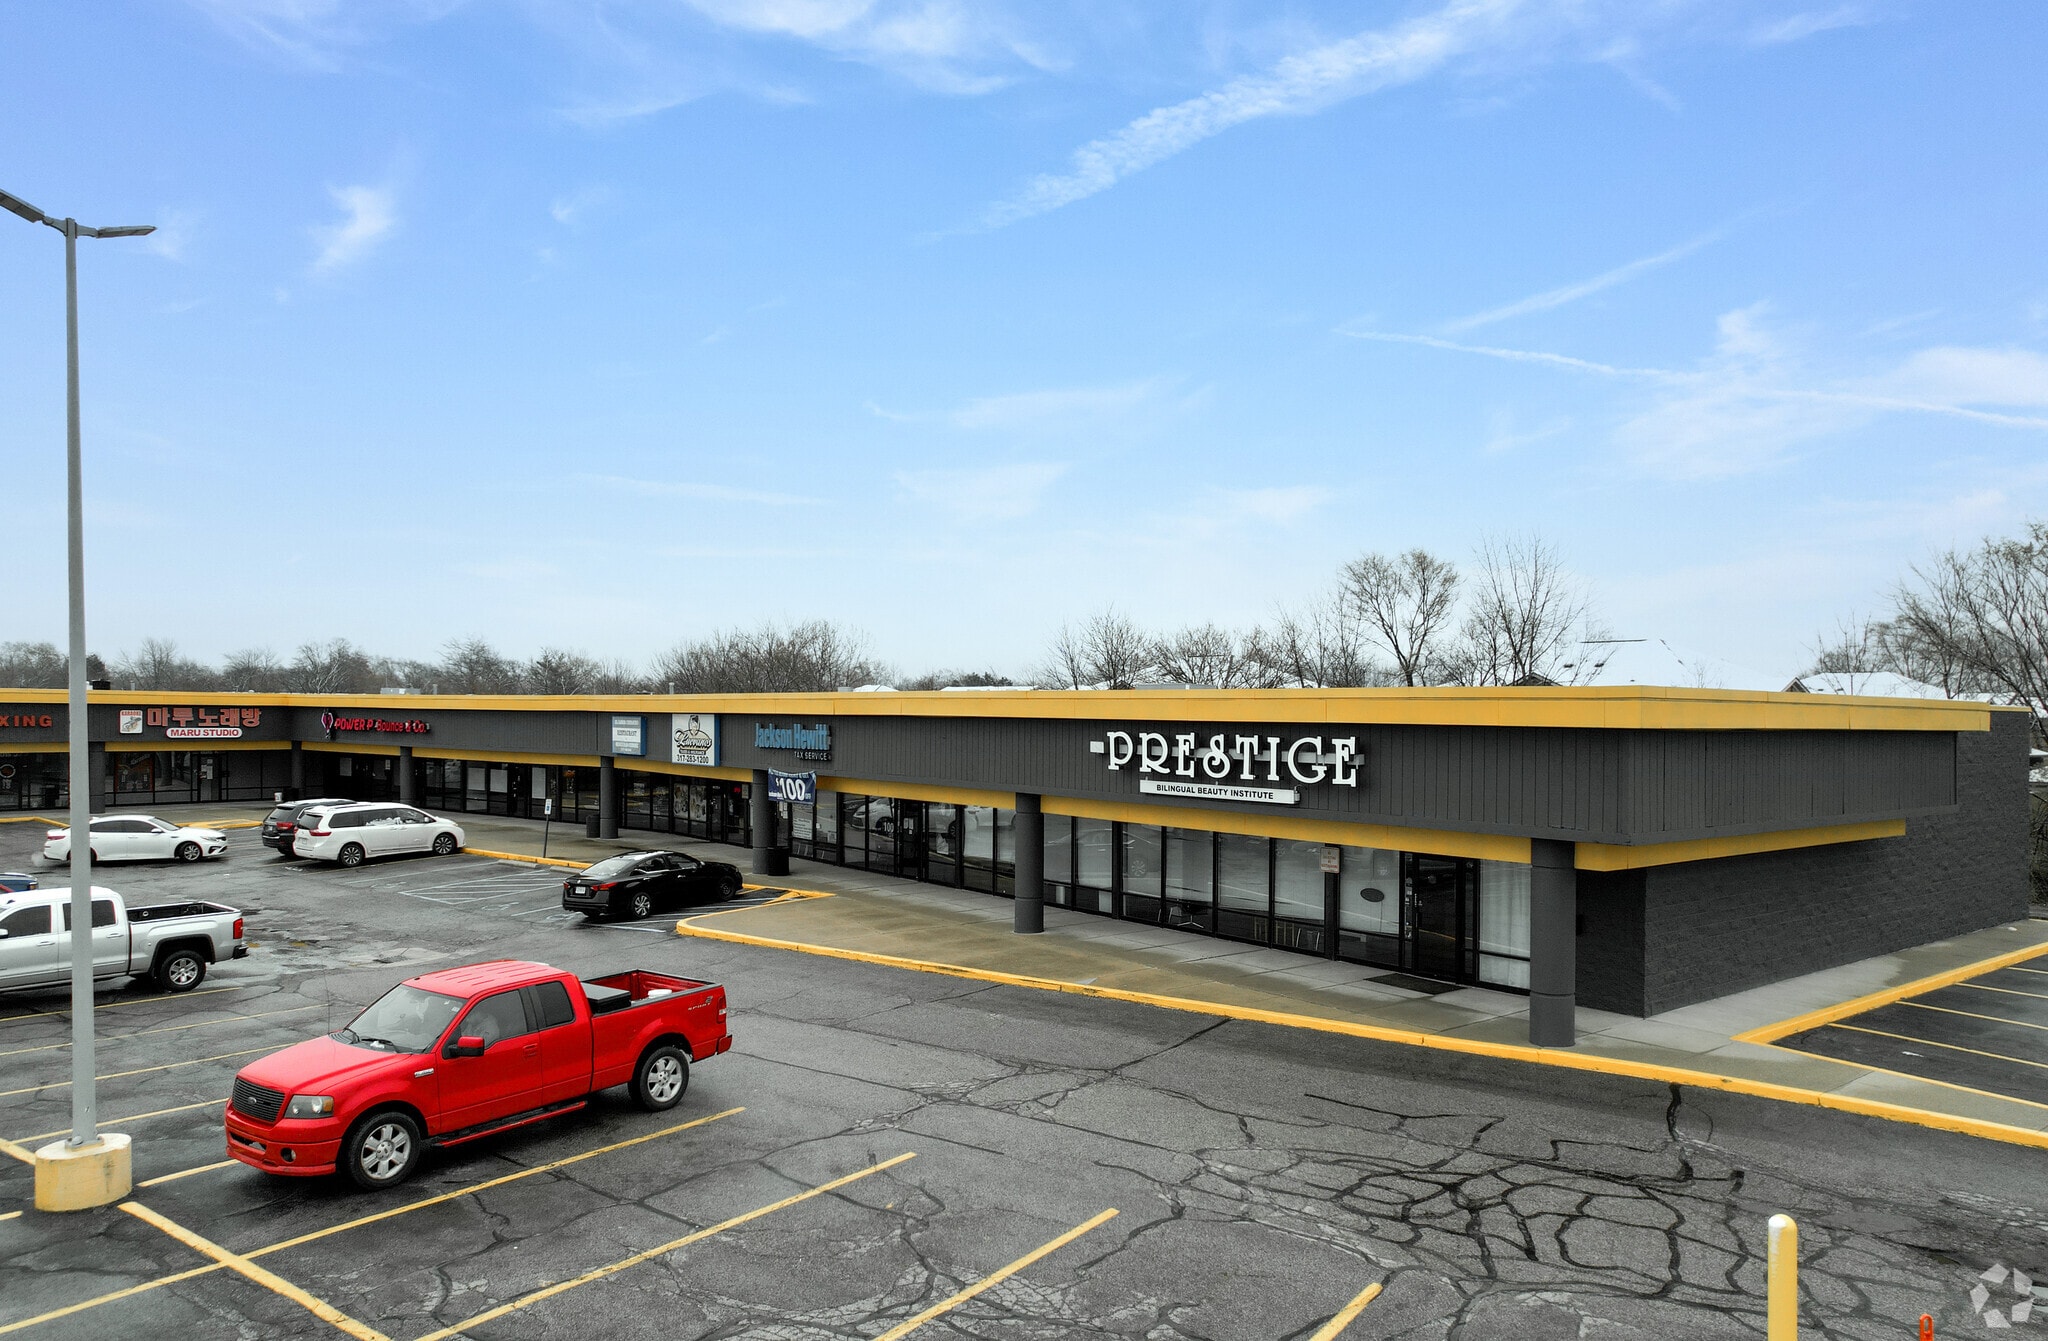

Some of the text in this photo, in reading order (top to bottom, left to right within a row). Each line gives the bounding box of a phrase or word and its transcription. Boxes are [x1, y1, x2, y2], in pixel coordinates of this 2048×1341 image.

[198, 707, 262, 728] 노래방
[334, 717, 365, 731] POWER
[366, 718, 374, 731] P
[375, 719, 404, 732] Bounce
[170, 729, 239, 737] MARU STUDIO
[754, 722, 828, 750] Jackson Hewitt
[794, 751, 828, 760] TAX SERVICE
[1107, 731, 1357, 787] PRESTIGE
[1156, 784, 1274, 800] BILINGUAL BEAUTY INSTITUTE
